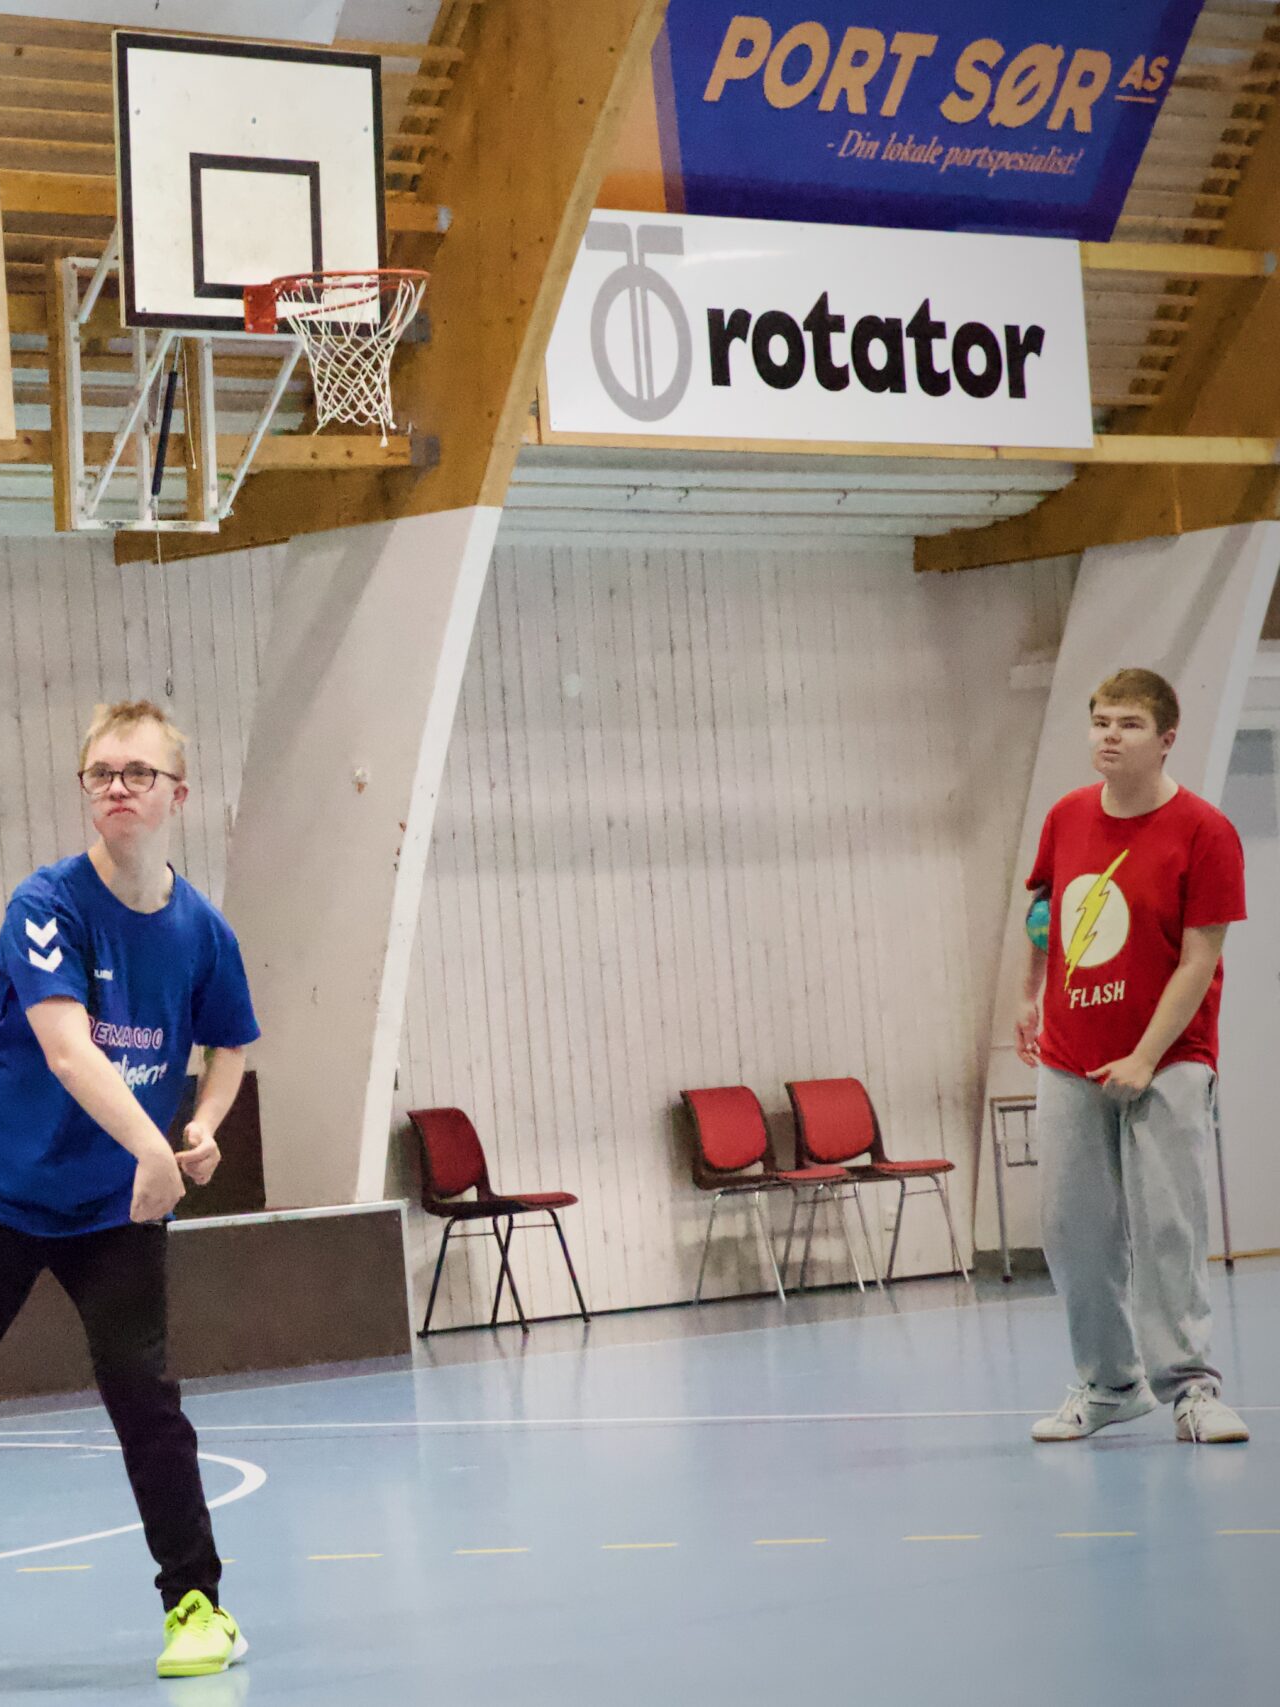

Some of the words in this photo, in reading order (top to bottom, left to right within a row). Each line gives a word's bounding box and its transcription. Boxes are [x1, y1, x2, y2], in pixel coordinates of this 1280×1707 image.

[702, 14, 939, 118] PORT
[939, 37, 1113, 134] SØR
[1118, 54, 1170, 93] AS
[837, 129, 881, 160] Din
[881, 131, 944, 165] lokale
[706, 291, 1046, 400] rotator
[1069, 979, 1126, 1009] FLASH
